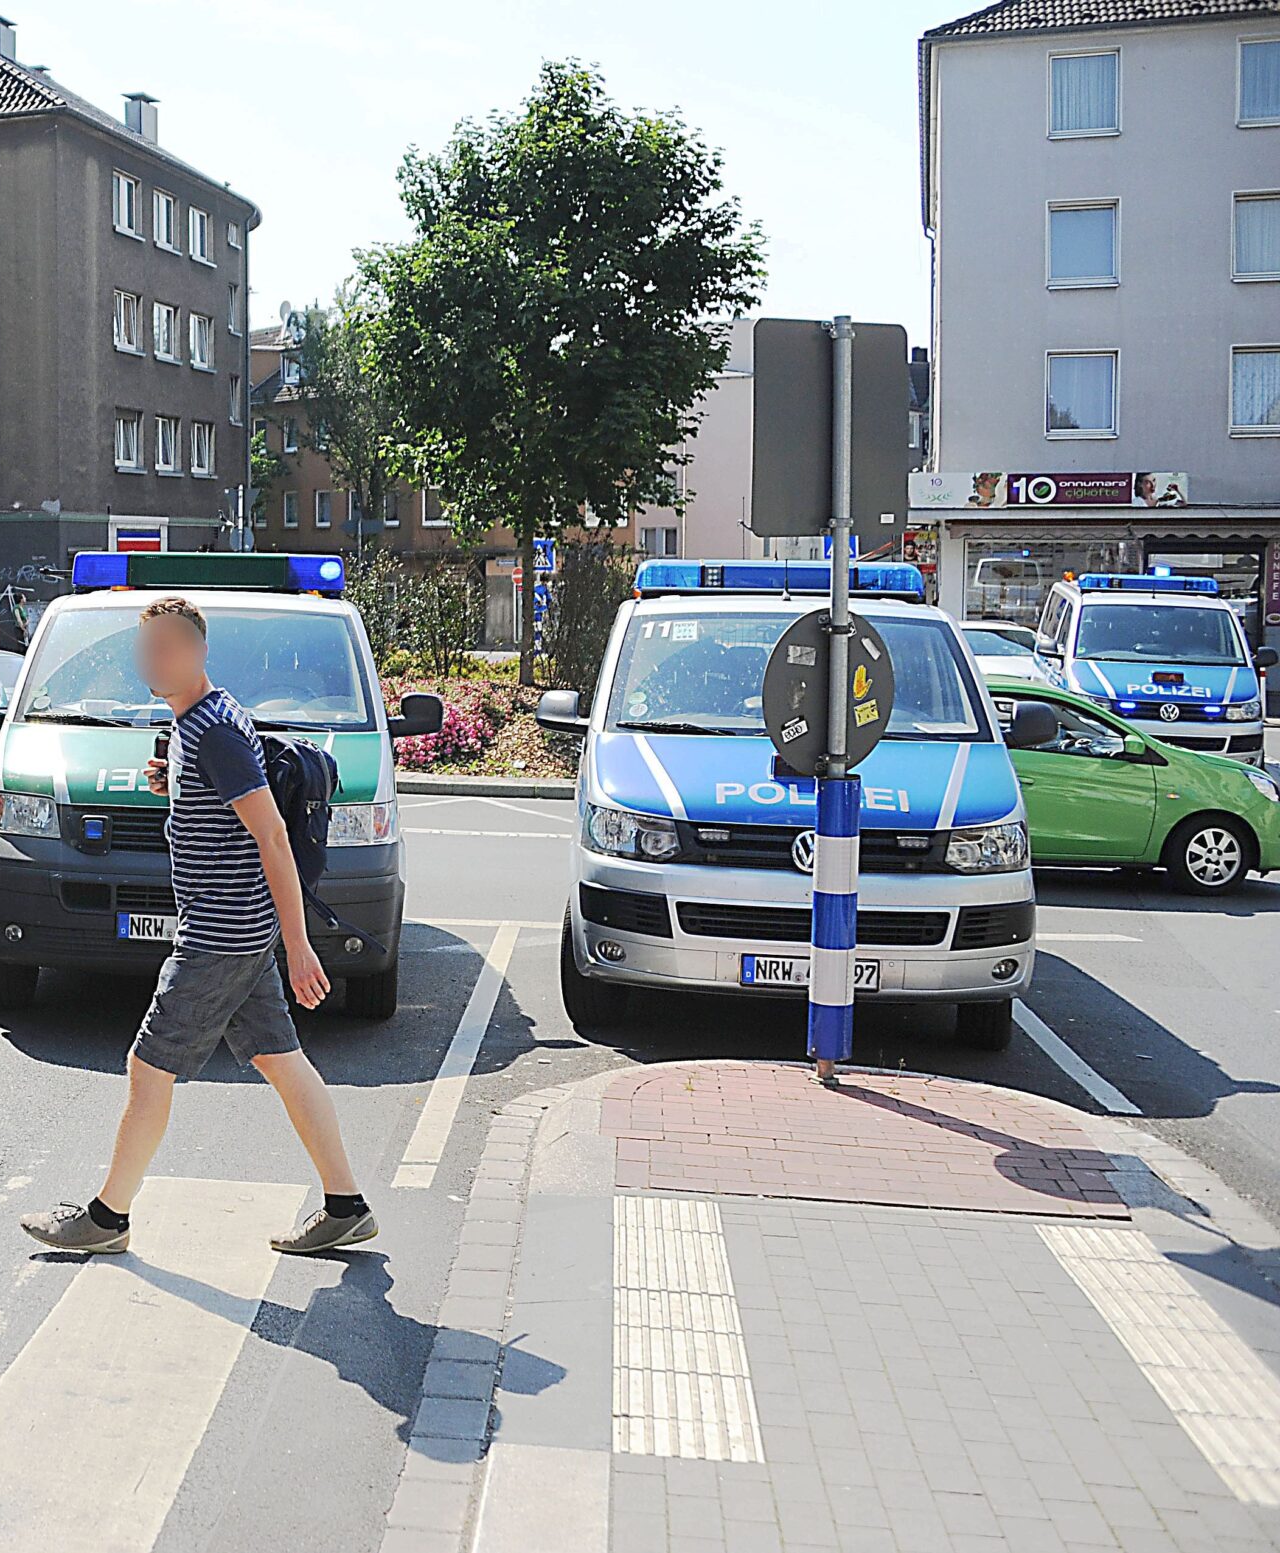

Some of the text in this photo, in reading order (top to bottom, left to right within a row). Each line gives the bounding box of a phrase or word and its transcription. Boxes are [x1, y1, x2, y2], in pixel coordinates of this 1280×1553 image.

[1012, 476, 1057, 504] 10
[1127, 683, 1211, 698] POLIZEI
[715, 783, 910, 812] POLEI
[130, 916, 165, 937] NRW
[755, 959, 793, 981] NRW
